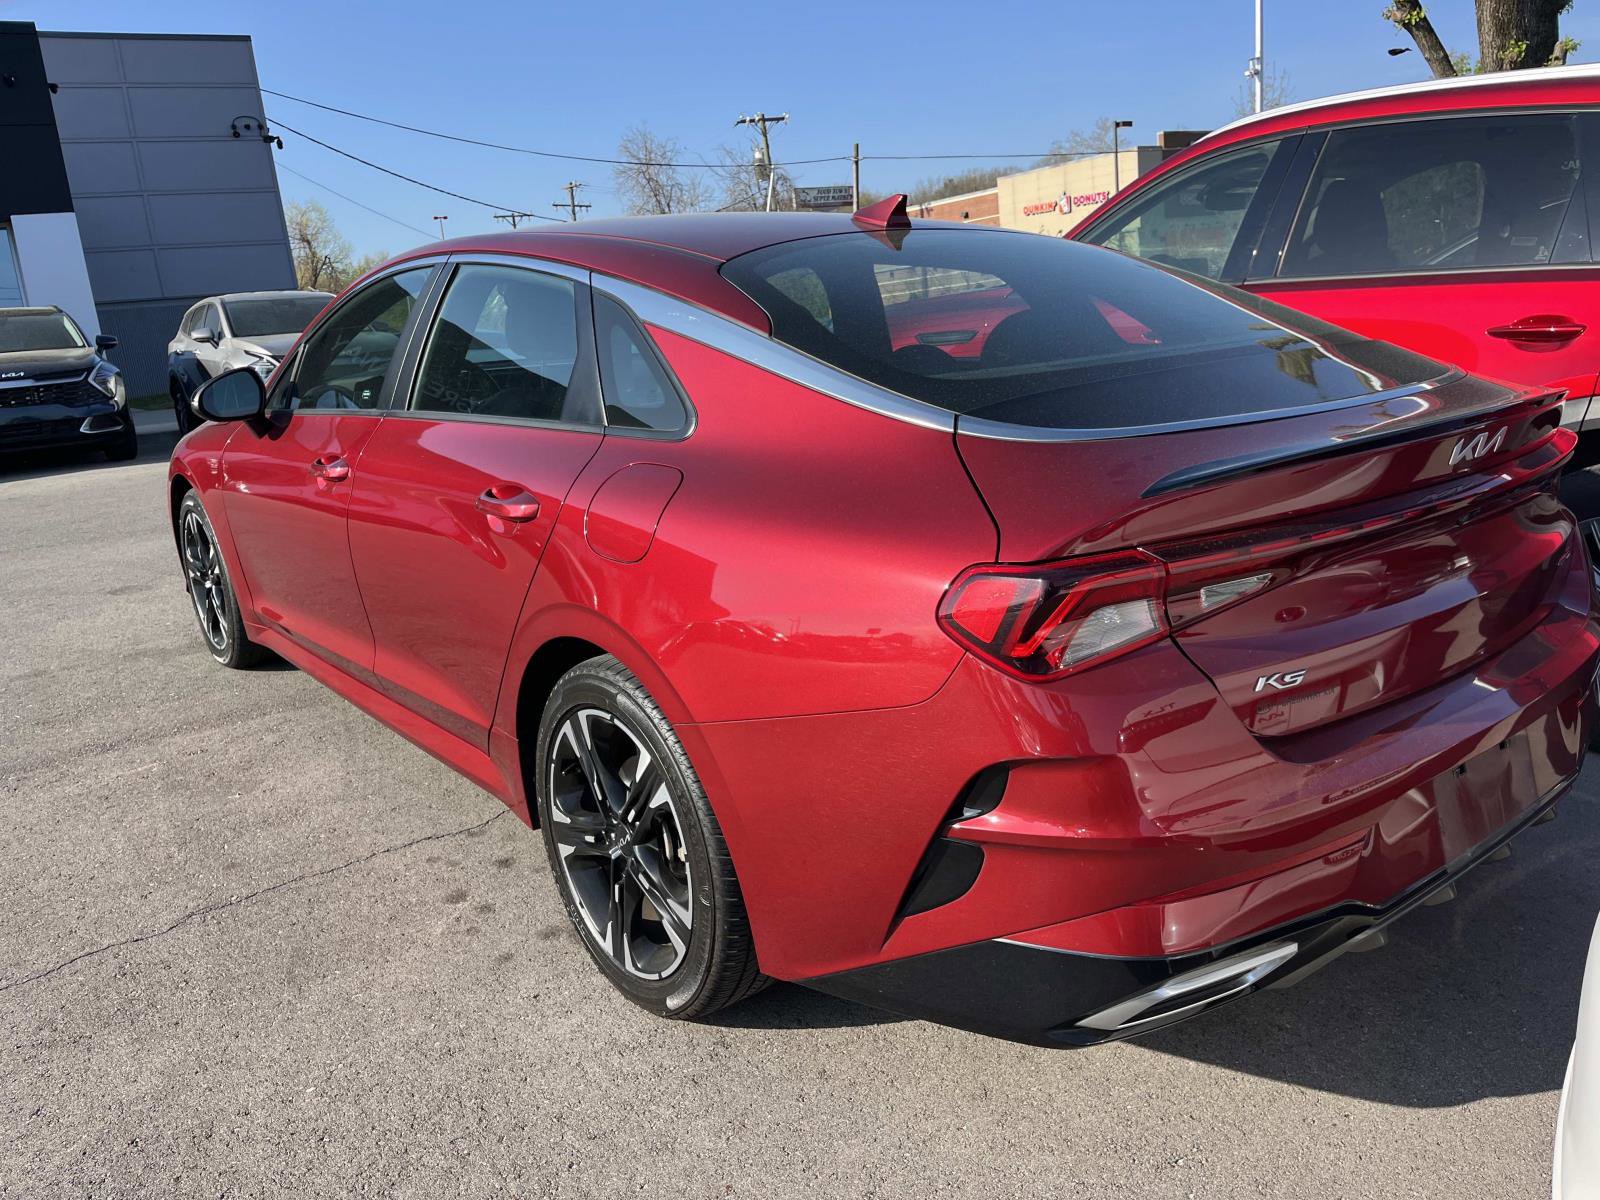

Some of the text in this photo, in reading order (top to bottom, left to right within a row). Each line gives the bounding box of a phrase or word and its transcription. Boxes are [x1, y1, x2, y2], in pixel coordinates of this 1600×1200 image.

[1073, 192, 1107, 206] DONUTS
[1448, 426, 1508, 465] KIA
[1254, 669, 1307, 692] K5
